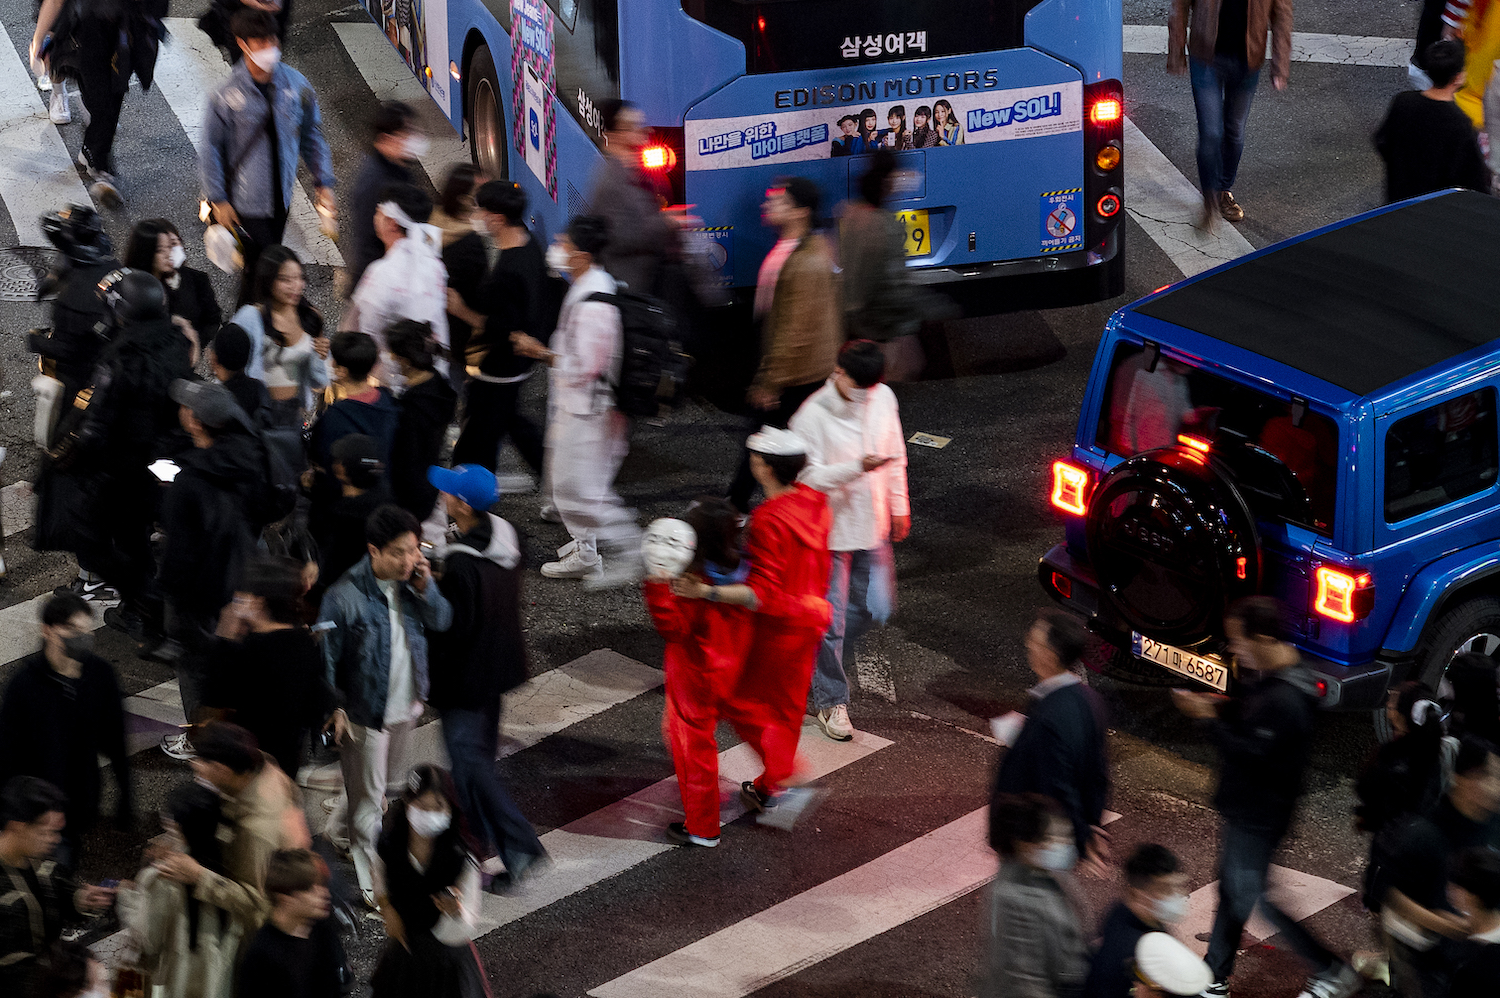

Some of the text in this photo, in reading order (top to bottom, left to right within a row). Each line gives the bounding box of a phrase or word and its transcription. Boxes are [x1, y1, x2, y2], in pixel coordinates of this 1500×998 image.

[520, 16, 552, 63] New SOL!
[840, 31, 928, 58] 삼성여객
[774, 68, 998, 109] EDISON MOTORS
[967, 108, 1013, 133] New
[1013, 91, 1062, 123] SOL!
[699, 121, 777, 155] 나만을 위한
[752, 123, 829, 160] 마이플랫폼
[1049, 195, 1074, 204] 우회전시
[1041, 234, 1081, 247] 끼어들기 금지
[1186, 657, 1224, 684] 6587
